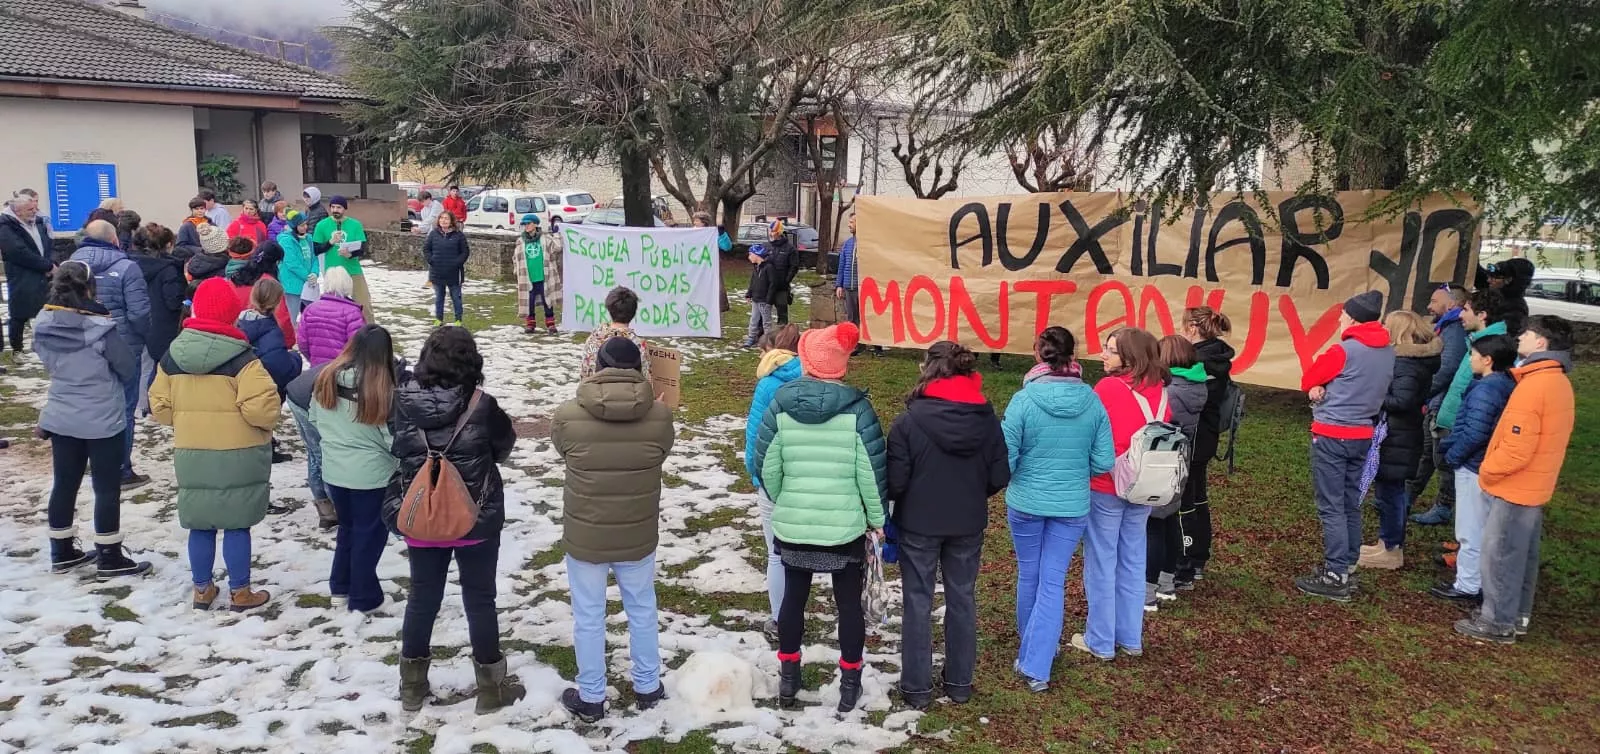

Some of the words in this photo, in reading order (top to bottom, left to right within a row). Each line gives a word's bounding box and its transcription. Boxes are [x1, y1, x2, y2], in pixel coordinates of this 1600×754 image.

[565, 228, 630, 262] ESCUELA
[592, 264, 616, 288] DE
[626, 270, 691, 296] TODAS
[574, 293, 611, 327] PAR
[859, 274, 1345, 377] MONTANUY
